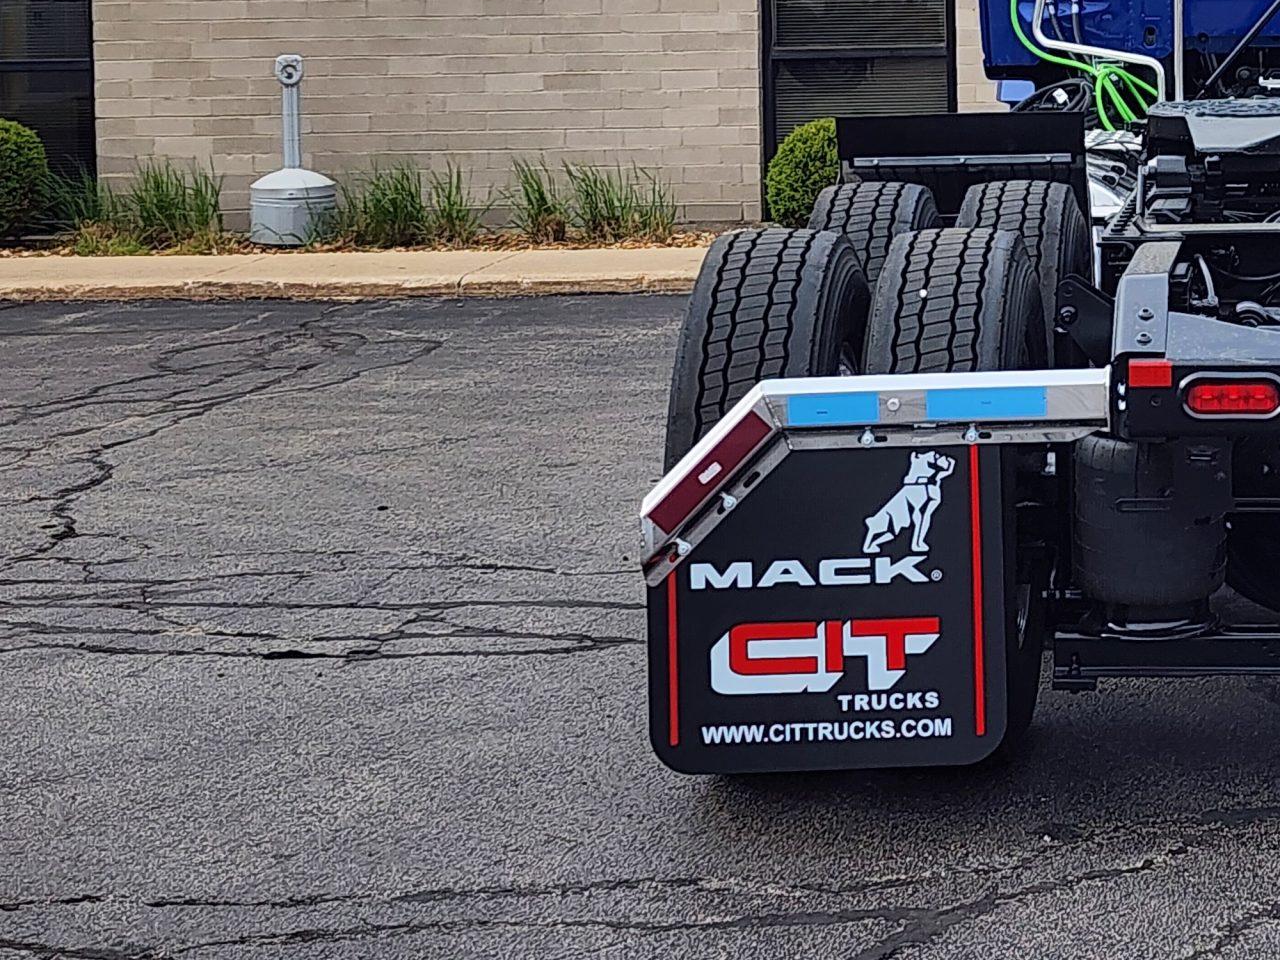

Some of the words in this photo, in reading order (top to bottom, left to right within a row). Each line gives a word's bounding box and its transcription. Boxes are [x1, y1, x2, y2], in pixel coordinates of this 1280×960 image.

[710, 616, 941, 695] CIT
[837, 691, 940, 712] TRUCKS
[701, 717, 952, 744] WWW.CITTRUCKS.COM
